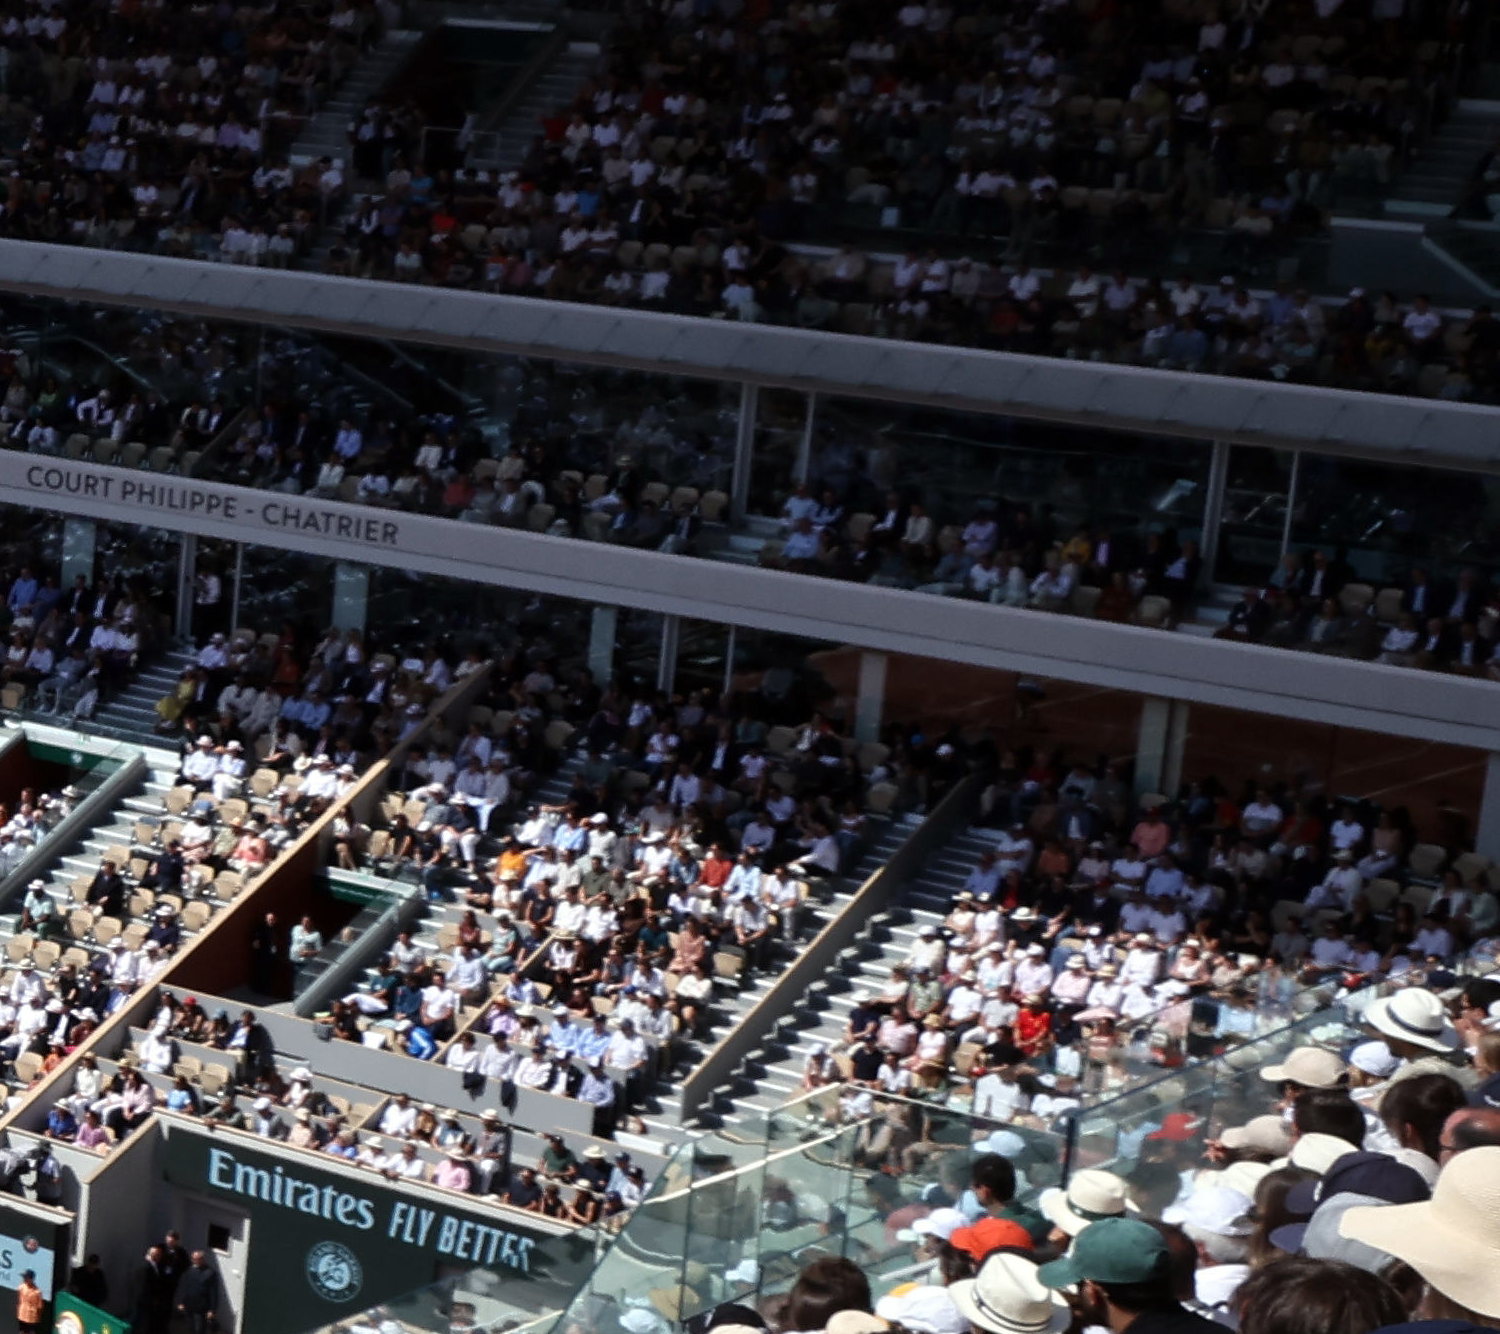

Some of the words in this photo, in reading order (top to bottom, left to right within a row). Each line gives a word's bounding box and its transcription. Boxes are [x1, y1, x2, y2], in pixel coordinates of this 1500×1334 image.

[26, 466, 114, 500] COURT
[122, 480, 238, 519] PHILIPPE
[261, 502, 400, 546] CHATRIER
[207, 1148, 374, 1230] Emirates
[387, 1201, 436, 1247] FLY
